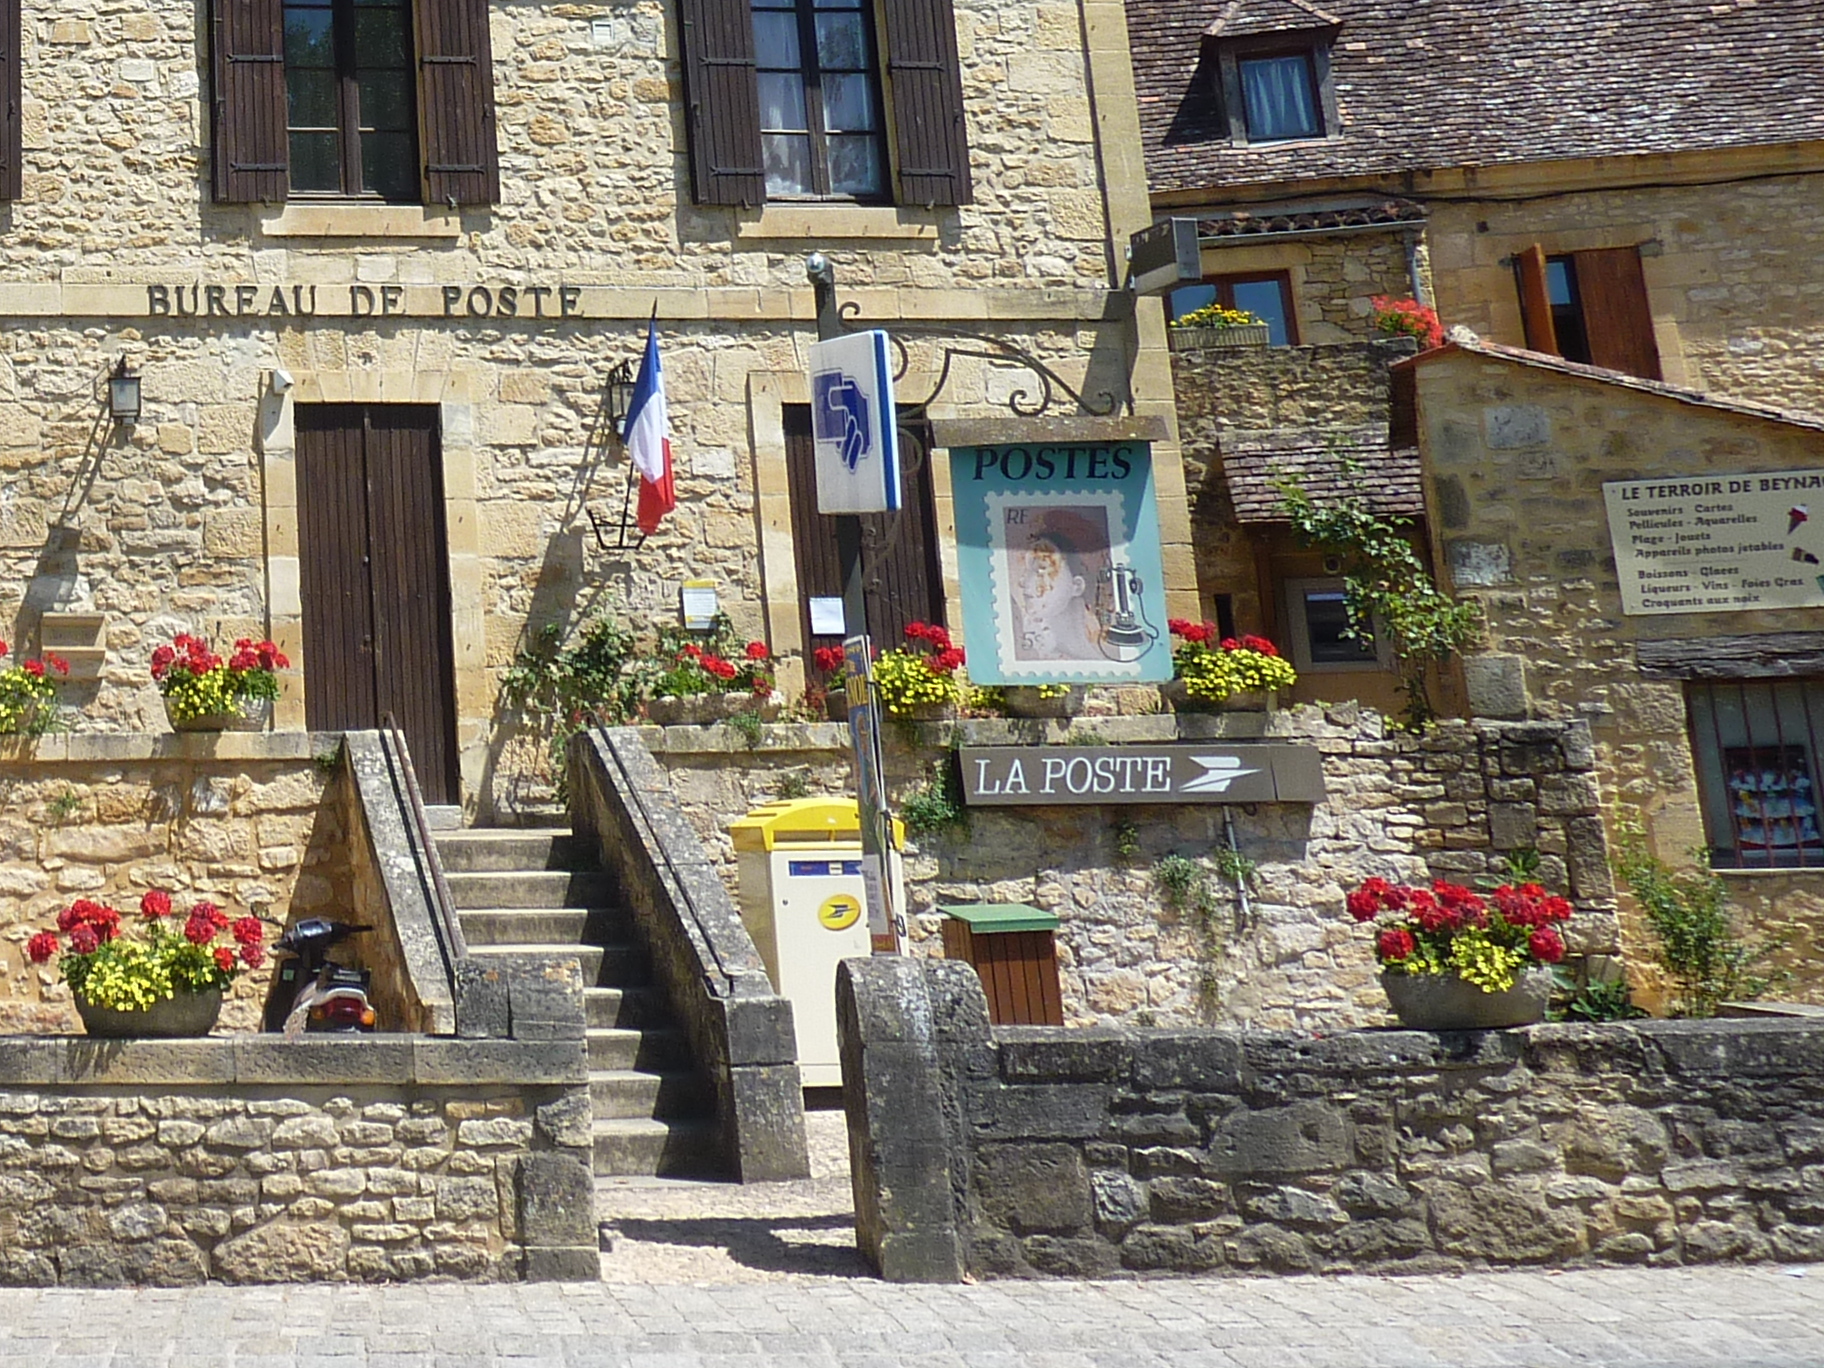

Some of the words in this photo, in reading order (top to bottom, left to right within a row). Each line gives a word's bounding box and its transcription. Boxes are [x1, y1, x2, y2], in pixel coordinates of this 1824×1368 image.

[147, 283, 316, 317] BUREAU
[350, 285, 404, 318] DE
[442, 285, 584, 319] POSTE
[973, 447, 1133, 481] POSTES
[1622, 488, 1640, 500] LE
[1646, 482, 1723, 498] TERROIR
[1729, 480, 1752, 494] DE
[1760, 475, 1824, 492] BEYNA
[1627, 508, 1683, 517] Souvenirs
[1695, 504, 1733, 513] Cartes
[1629, 520, 1683, 529] Pellicules
[1695, 515, 1757, 526] Aquarelles
[1632, 535, 1664, 544] Plage
[1676, 533, 1711, 544] Jouets
[1635, 548, 1691, 558] Appareils
[1695, 545, 1734, 556] photos
[1738, 542, 1784, 554] jetables
[1638, 570, 1688, 579] Boissons
[1700, 567, 1739, 577] Glaces
[1641, 584, 1691, 595] Liqueurs
[1702, 581, 1729, 591] Vins
[1742, 579, 1770, 589] Foies
[1774, 577, 1804, 587] Gras
[1642, 598, 1703, 609] Croquants
[1733, 595, 1760, 604] noix
[974, 758, 1031, 794] LA
[1039, 757, 1171, 794] POSTE
